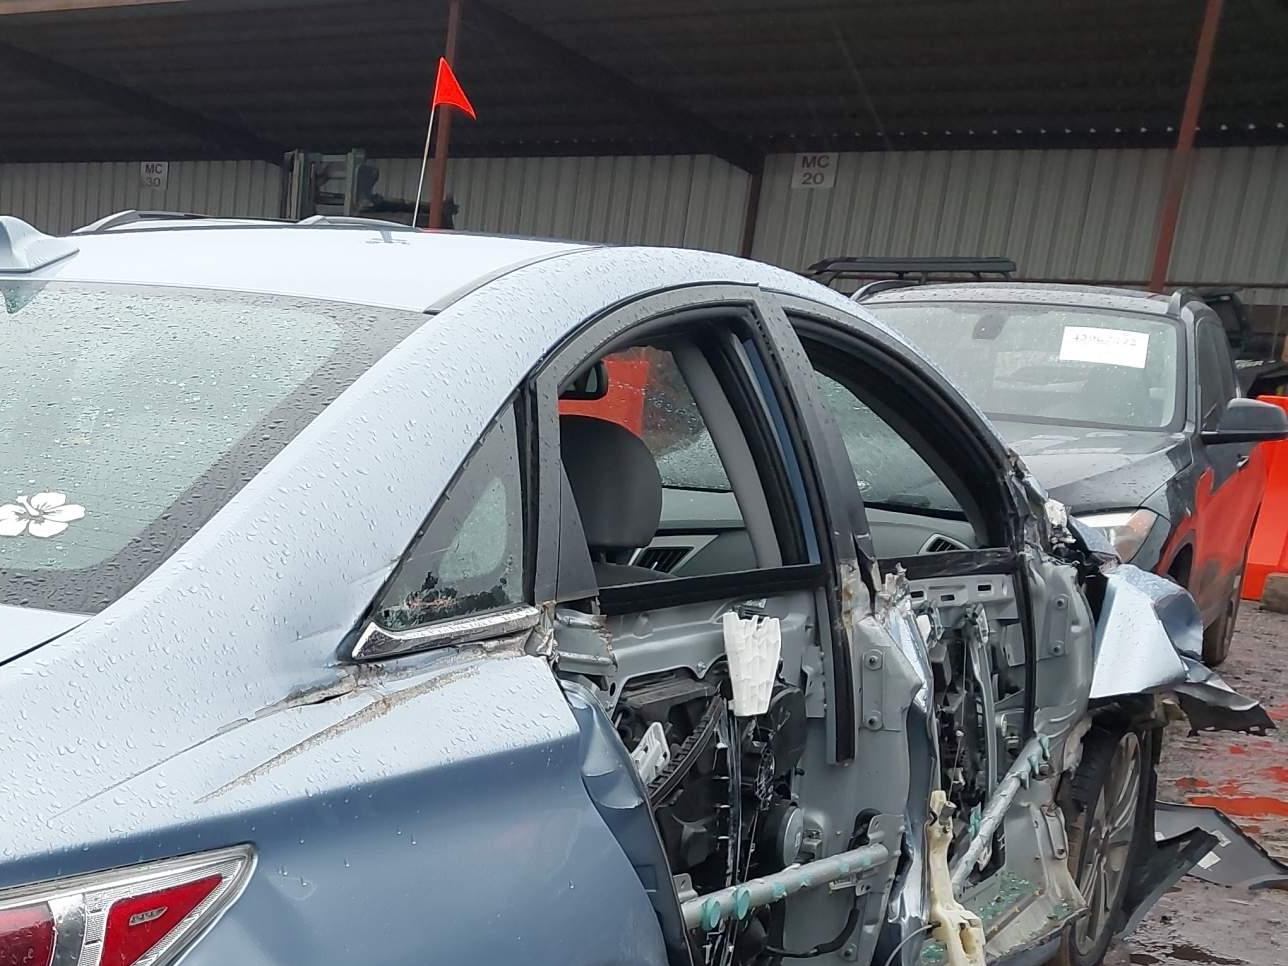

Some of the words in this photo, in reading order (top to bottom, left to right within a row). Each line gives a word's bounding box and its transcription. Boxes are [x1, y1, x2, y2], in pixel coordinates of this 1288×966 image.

[145, 163, 162, 174] MC
[802, 155, 830, 169] MC
[801, 172, 824, 185] 20
